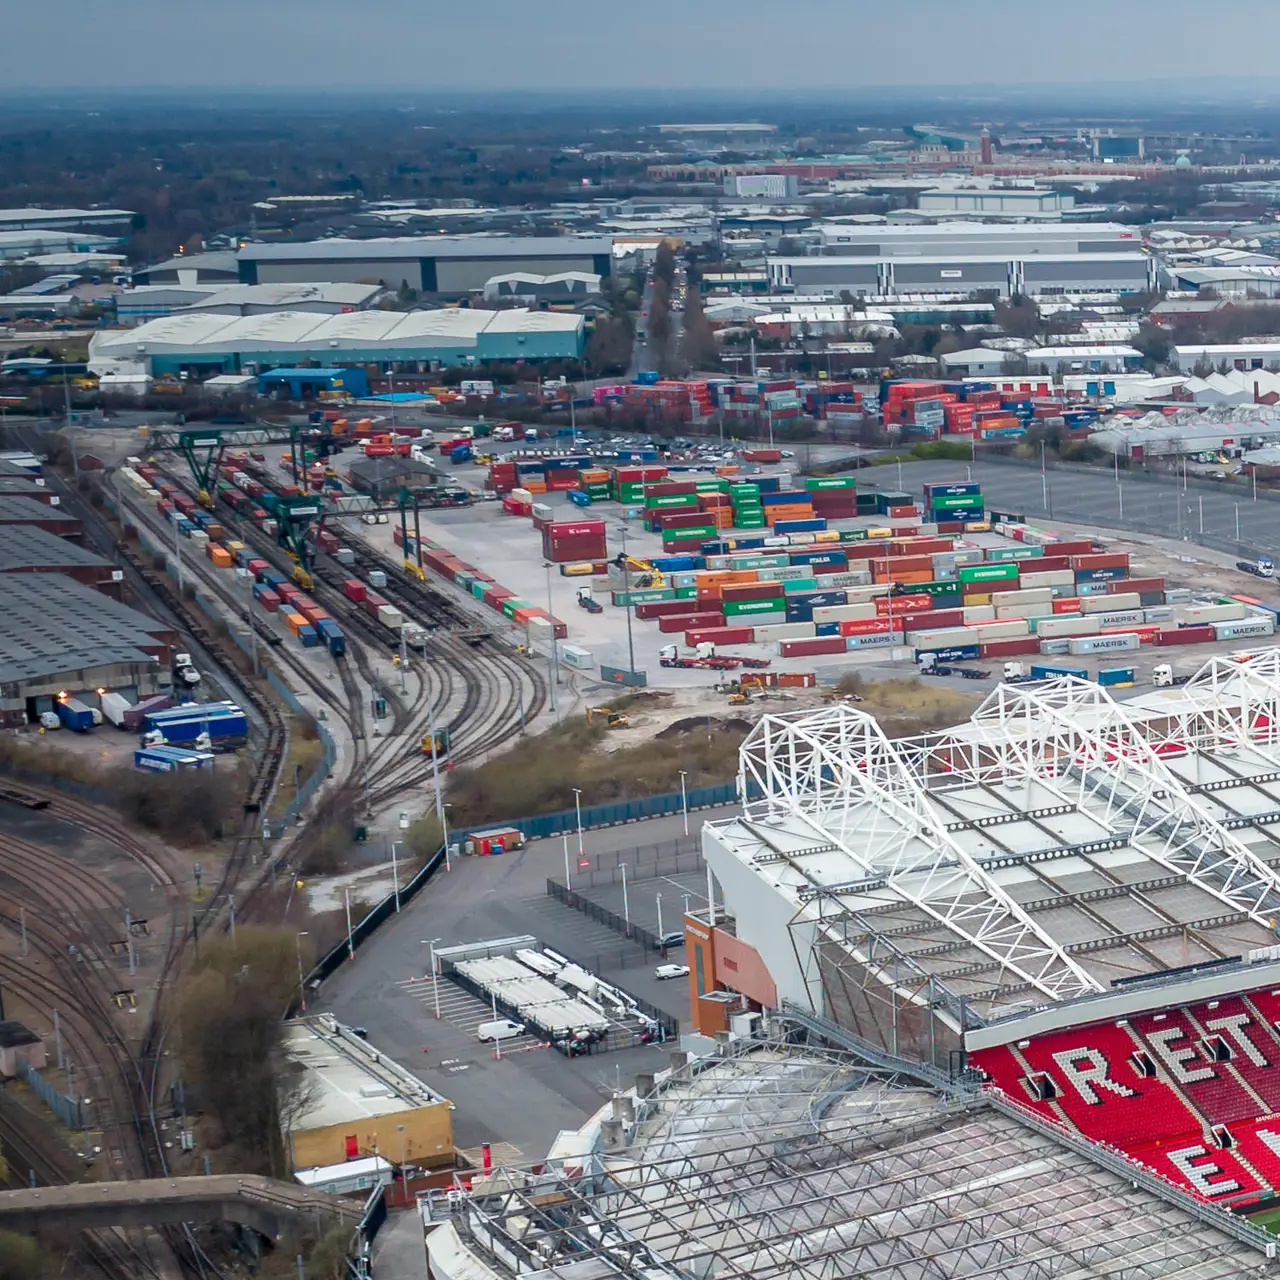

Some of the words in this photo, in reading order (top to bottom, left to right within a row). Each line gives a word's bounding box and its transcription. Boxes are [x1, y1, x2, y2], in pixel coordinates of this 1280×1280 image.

[809, 556, 830, 564] ITALIA
[1103, 615, 1137, 624] MAERSK
[1232, 626, 1267, 636] MAERSK
[1092, 640, 1128, 649] MAERSK
